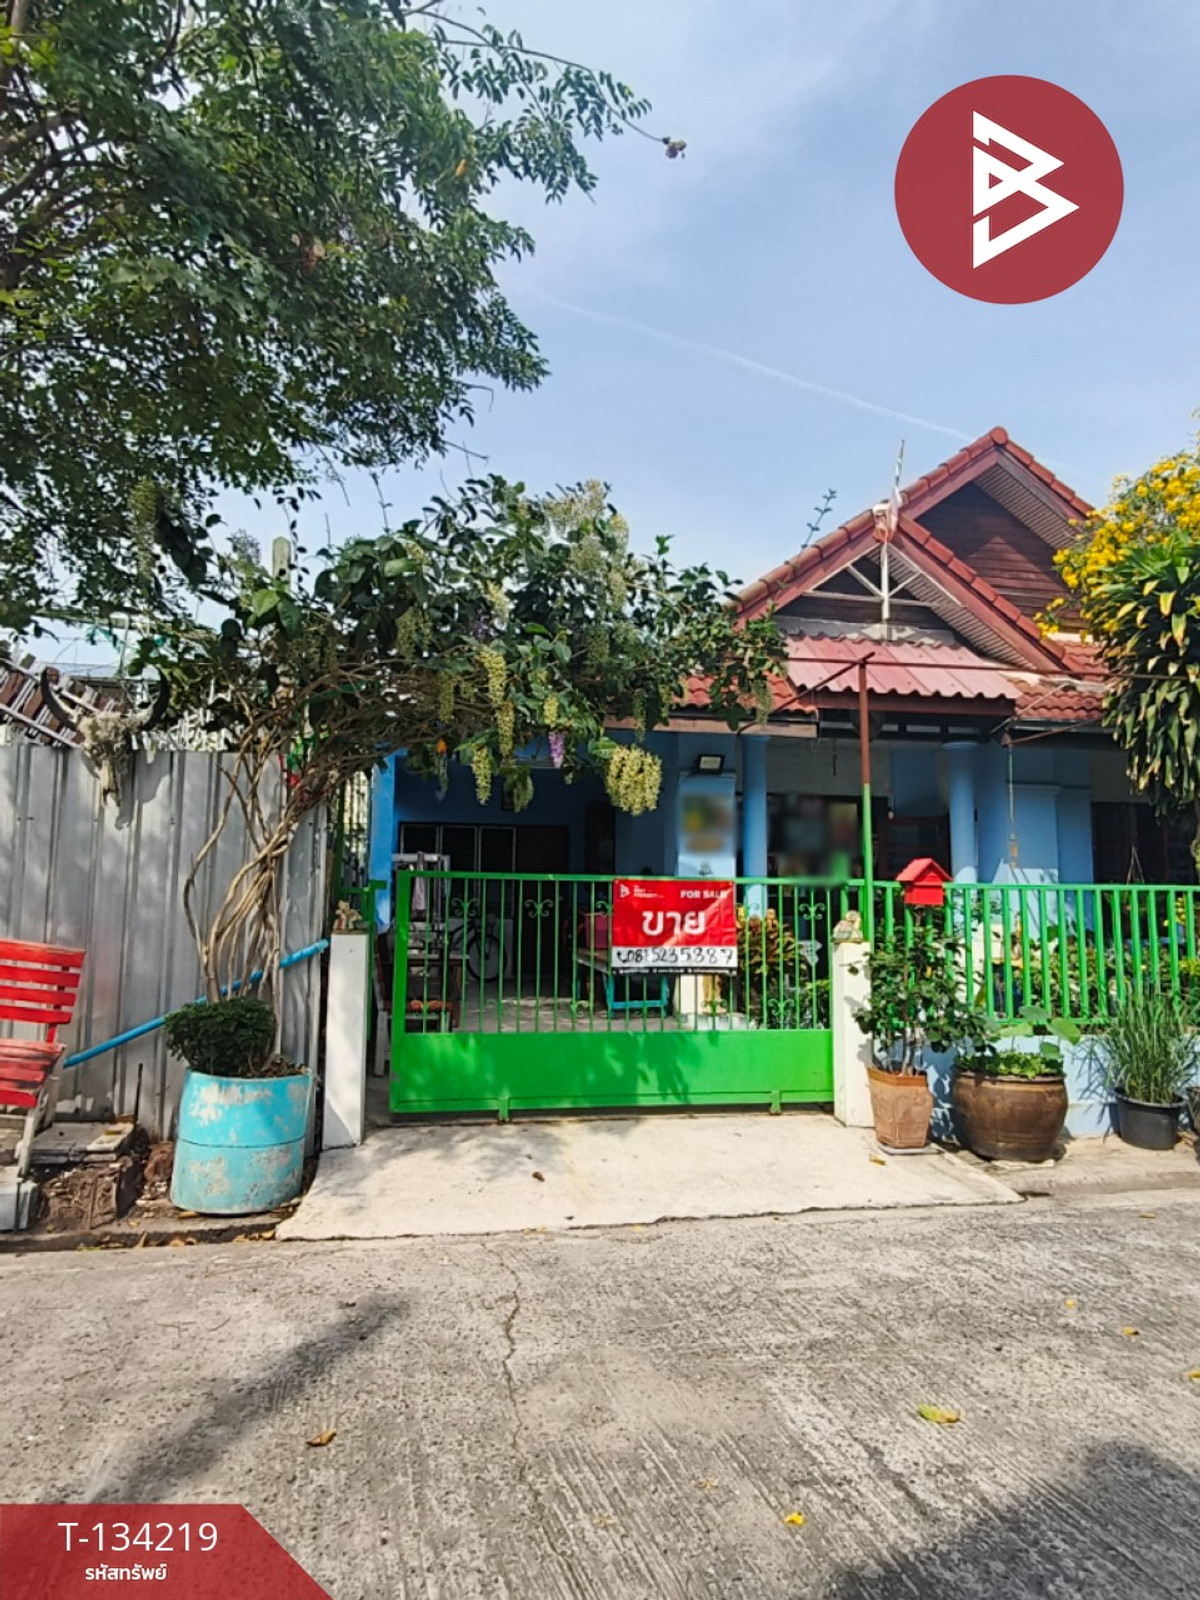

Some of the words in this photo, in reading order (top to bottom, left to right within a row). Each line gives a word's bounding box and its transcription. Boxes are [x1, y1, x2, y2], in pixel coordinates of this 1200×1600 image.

[680, 889, 701, 899] FOR
[702, 889, 727, 899] SALE
[642, 911, 706, 936] ขาย
